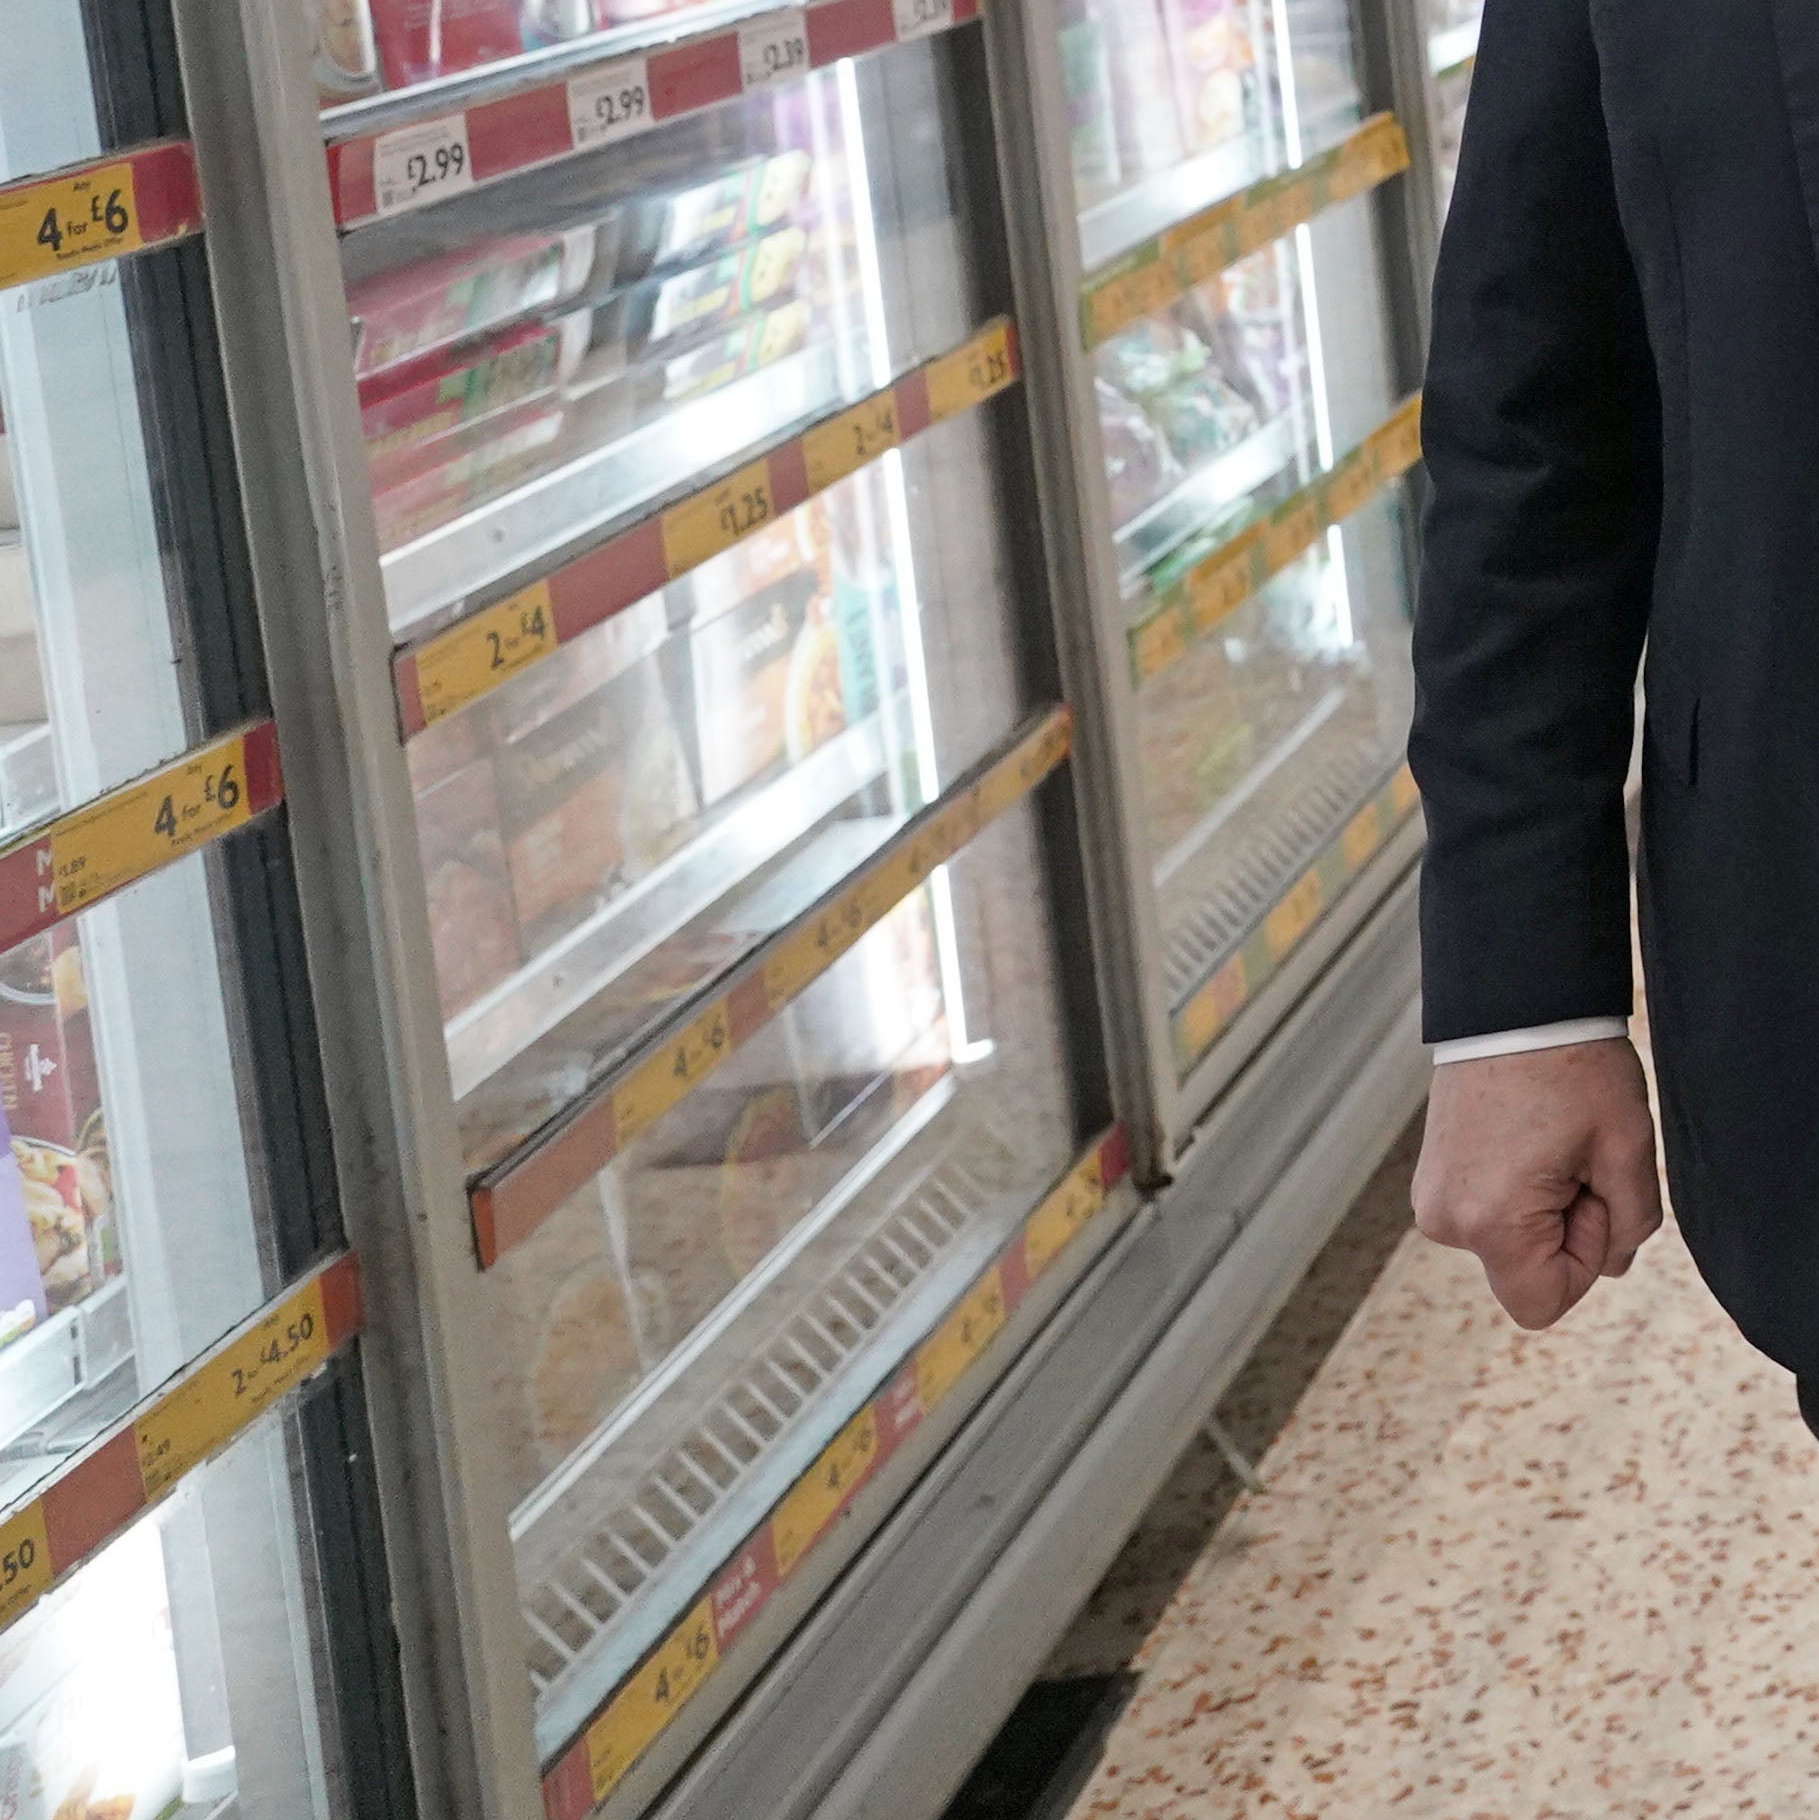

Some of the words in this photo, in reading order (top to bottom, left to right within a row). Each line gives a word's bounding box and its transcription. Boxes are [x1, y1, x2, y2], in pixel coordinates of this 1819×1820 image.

[596, 85, 646, 128] £2.99
[407, 142, 466, 190] £2.99
[37, 207, 62, 252] 4
[66, 220, 88, 238] for
[91, 189, 129, 234] £6
[487, 630, 505, 670] 2
[154, 795, 178, 838] 4
[181, 804, 201, 823] for
[203, 763, 240, 810] £6
[673, 1045, 688, 1078] 4
[231, 1367, 248, 1398] 2
[259, 1311, 314, 1365] £4.50
[654, 1668, 671, 1705] 4
